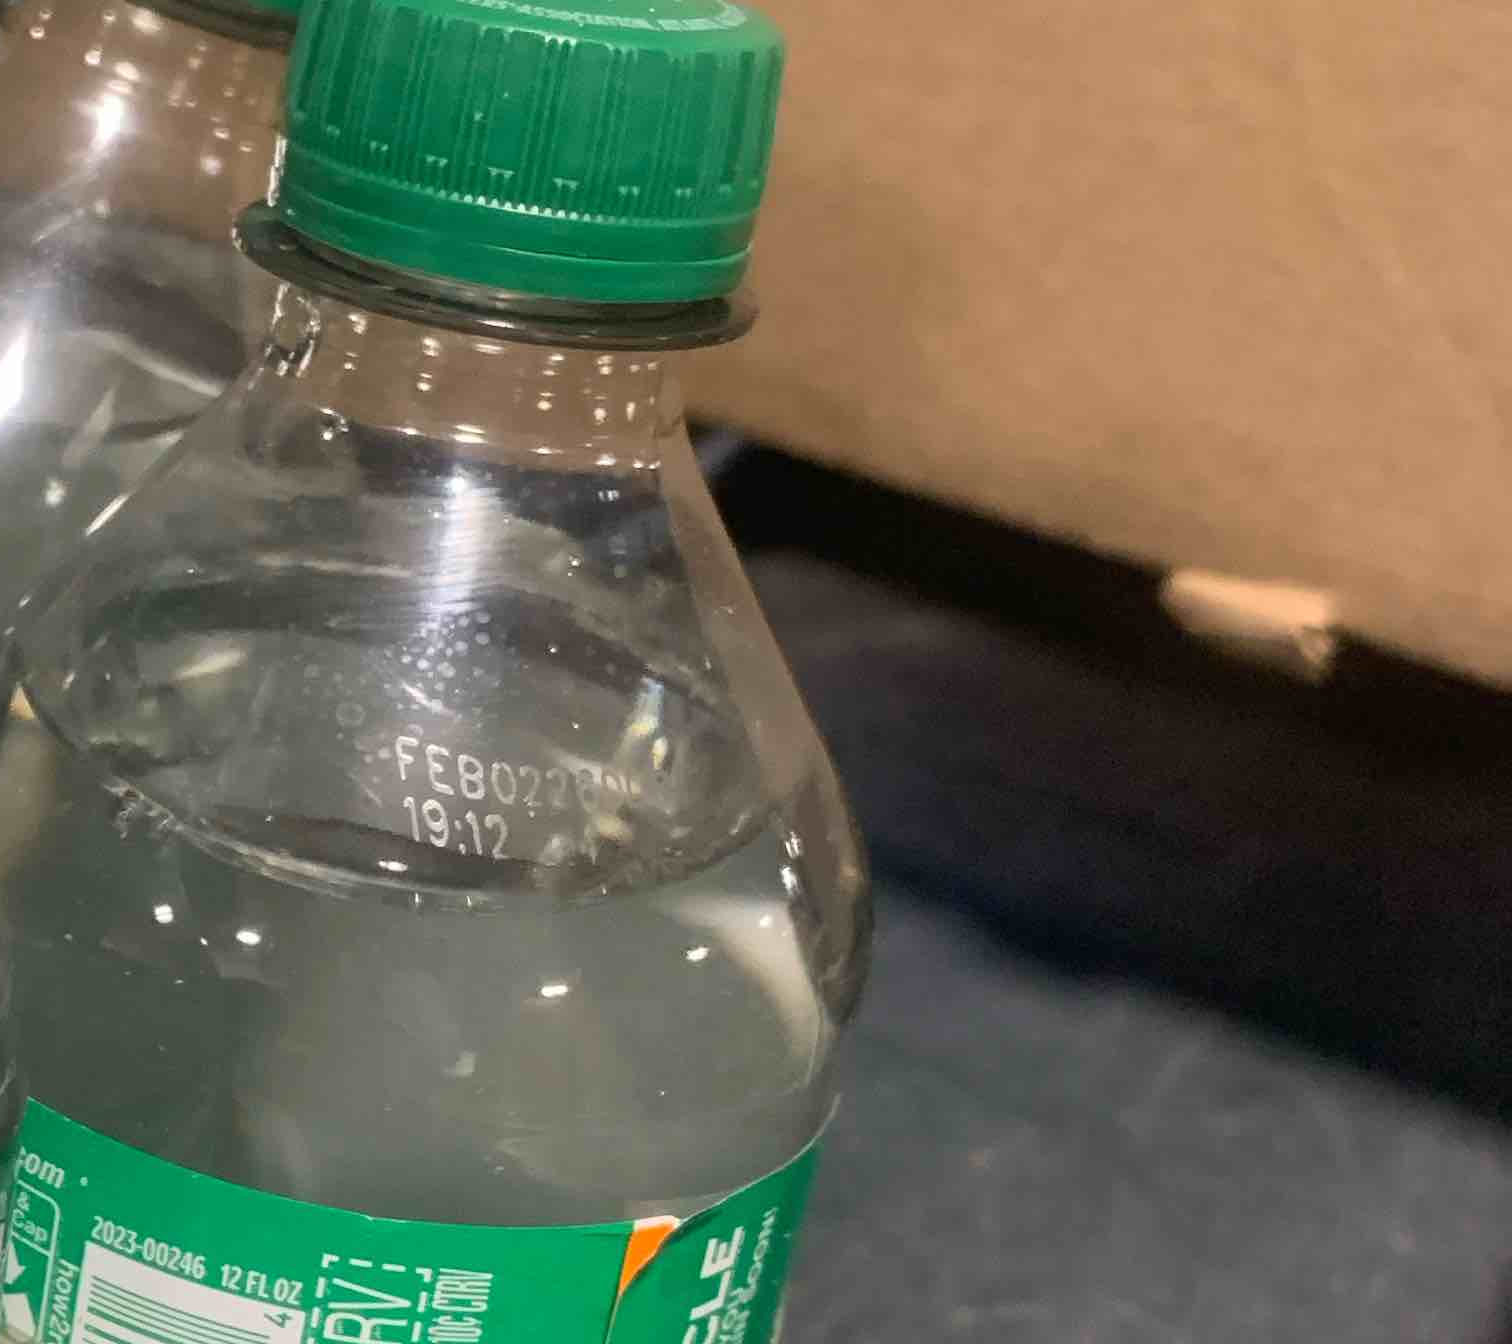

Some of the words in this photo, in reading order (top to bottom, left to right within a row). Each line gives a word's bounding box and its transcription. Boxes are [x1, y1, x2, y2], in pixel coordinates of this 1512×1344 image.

[91, 1216, 207, 1281] 2023-00246
[220, 1263, 243, 1291] 12
[245, 1269, 269, 1299] FL
[273, 1277, 304, 1306] OZ
[264, 1311, 293, 1329] 4
